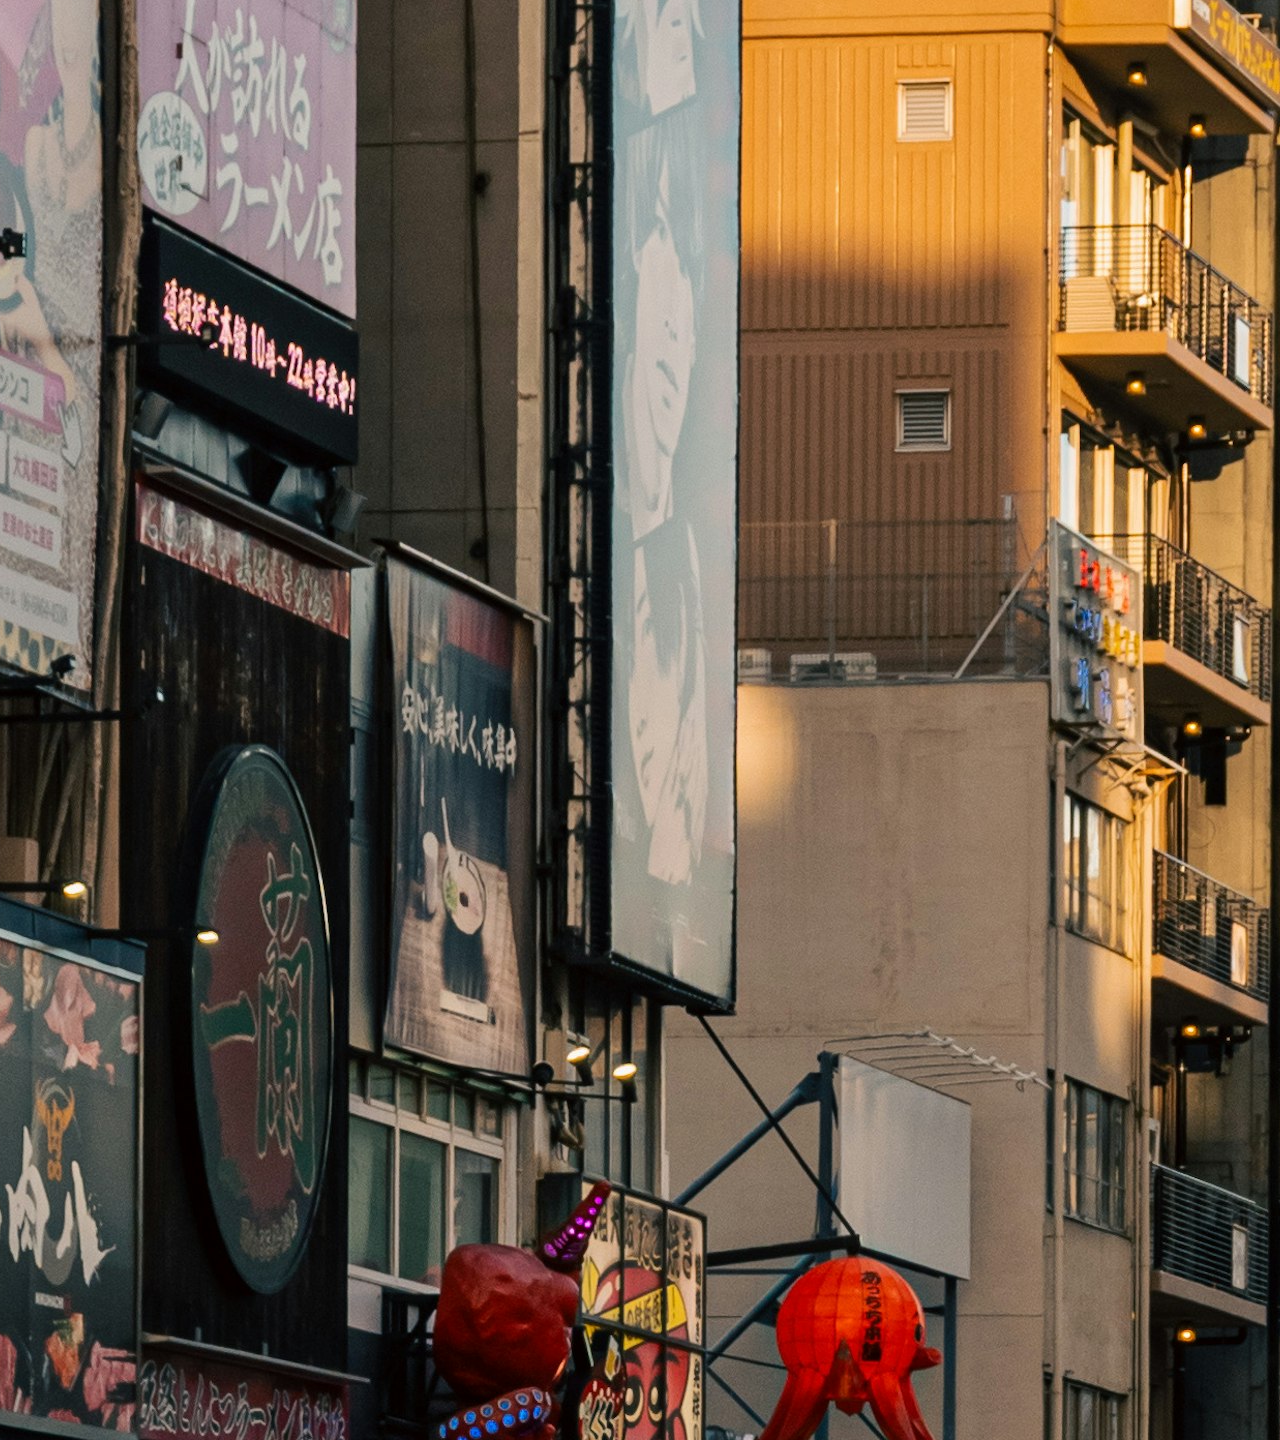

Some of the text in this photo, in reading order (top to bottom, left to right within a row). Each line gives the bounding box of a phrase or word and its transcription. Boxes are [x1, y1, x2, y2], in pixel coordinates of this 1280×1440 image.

[216, 133, 345, 288] ラーメン店
